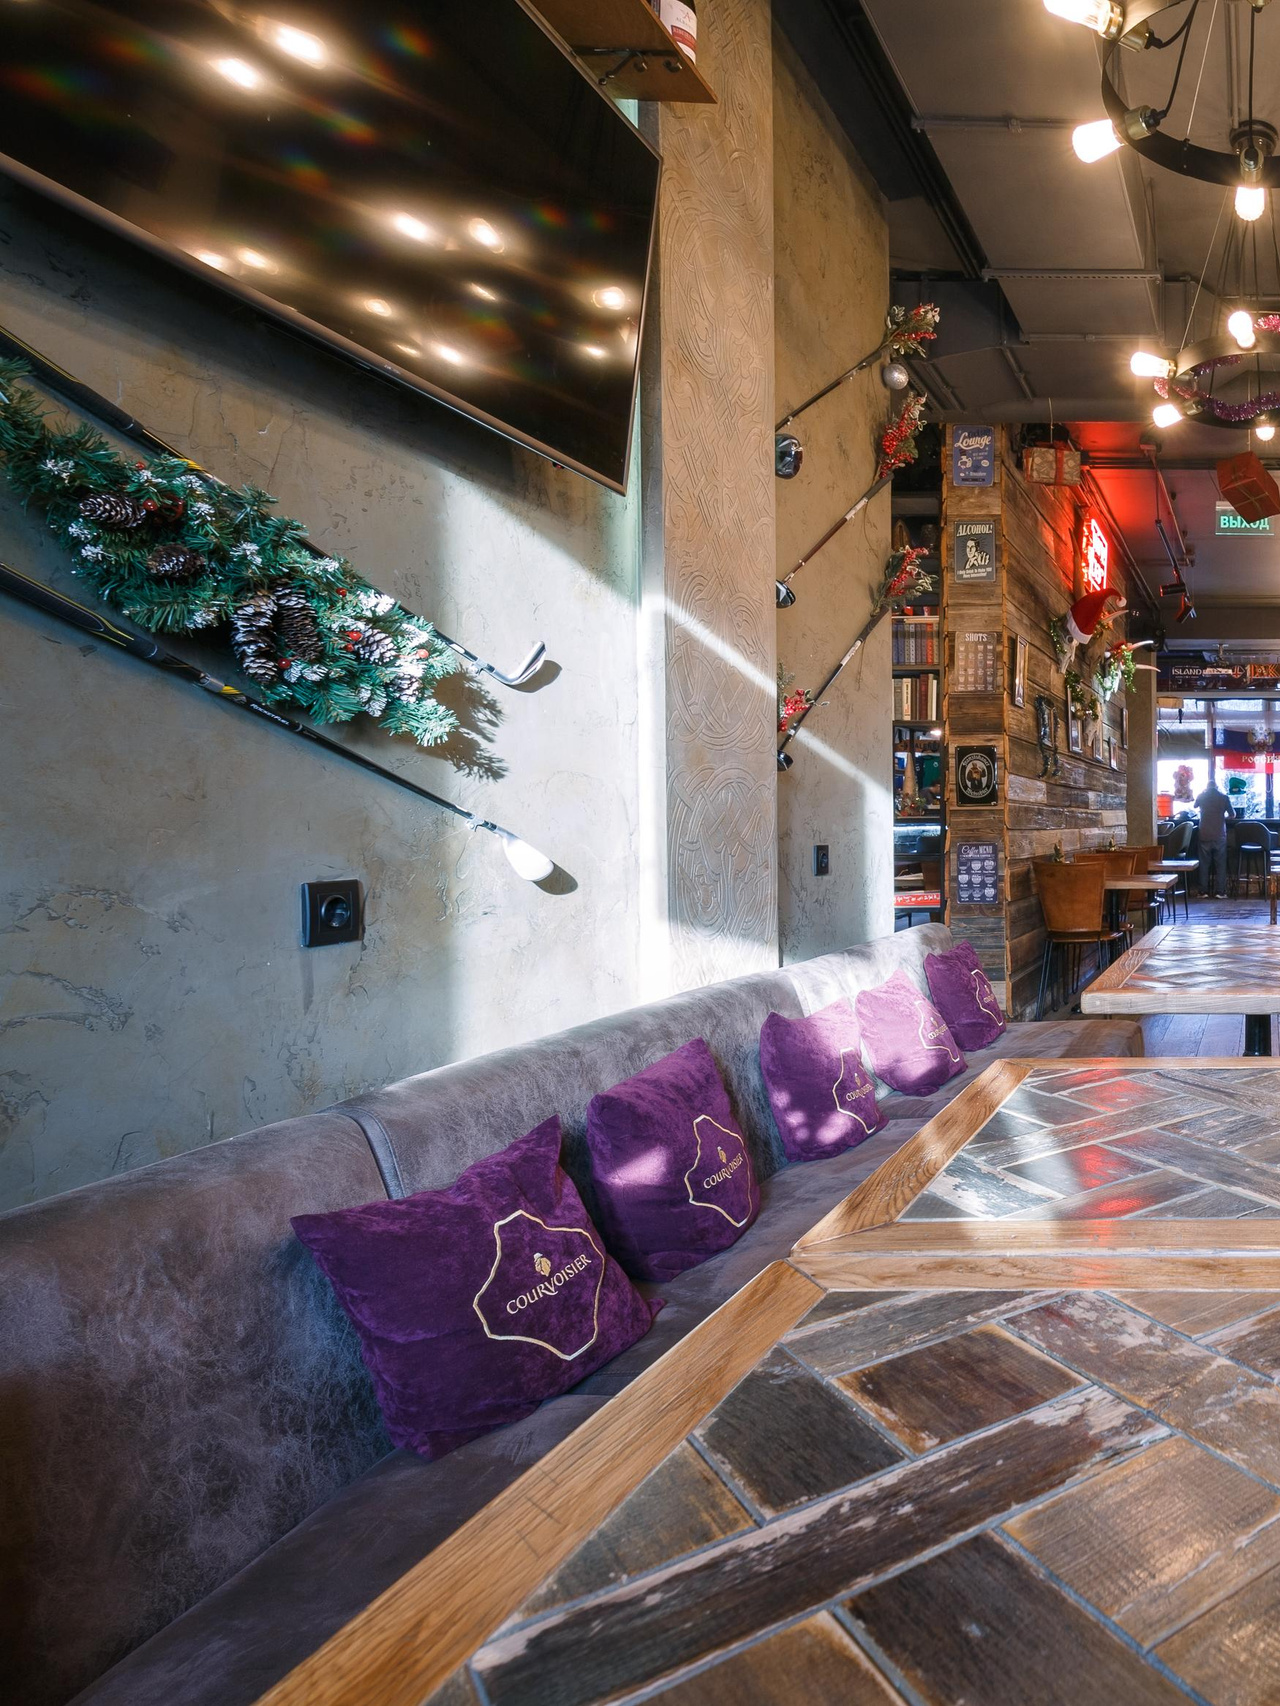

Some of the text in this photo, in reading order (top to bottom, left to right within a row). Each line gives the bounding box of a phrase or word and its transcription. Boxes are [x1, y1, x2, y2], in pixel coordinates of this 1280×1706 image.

[954, 432, 992, 450] Lounge
[956, 524, 993, 537] ALCOHOL!
[965, 633, 988, 642] SHOTS
[961, 845, 992, 856] Coffee MENU
[703, 1153, 744, 1189] COURVOISIER
[506, 1254, 592, 1315] COURVOISIER
